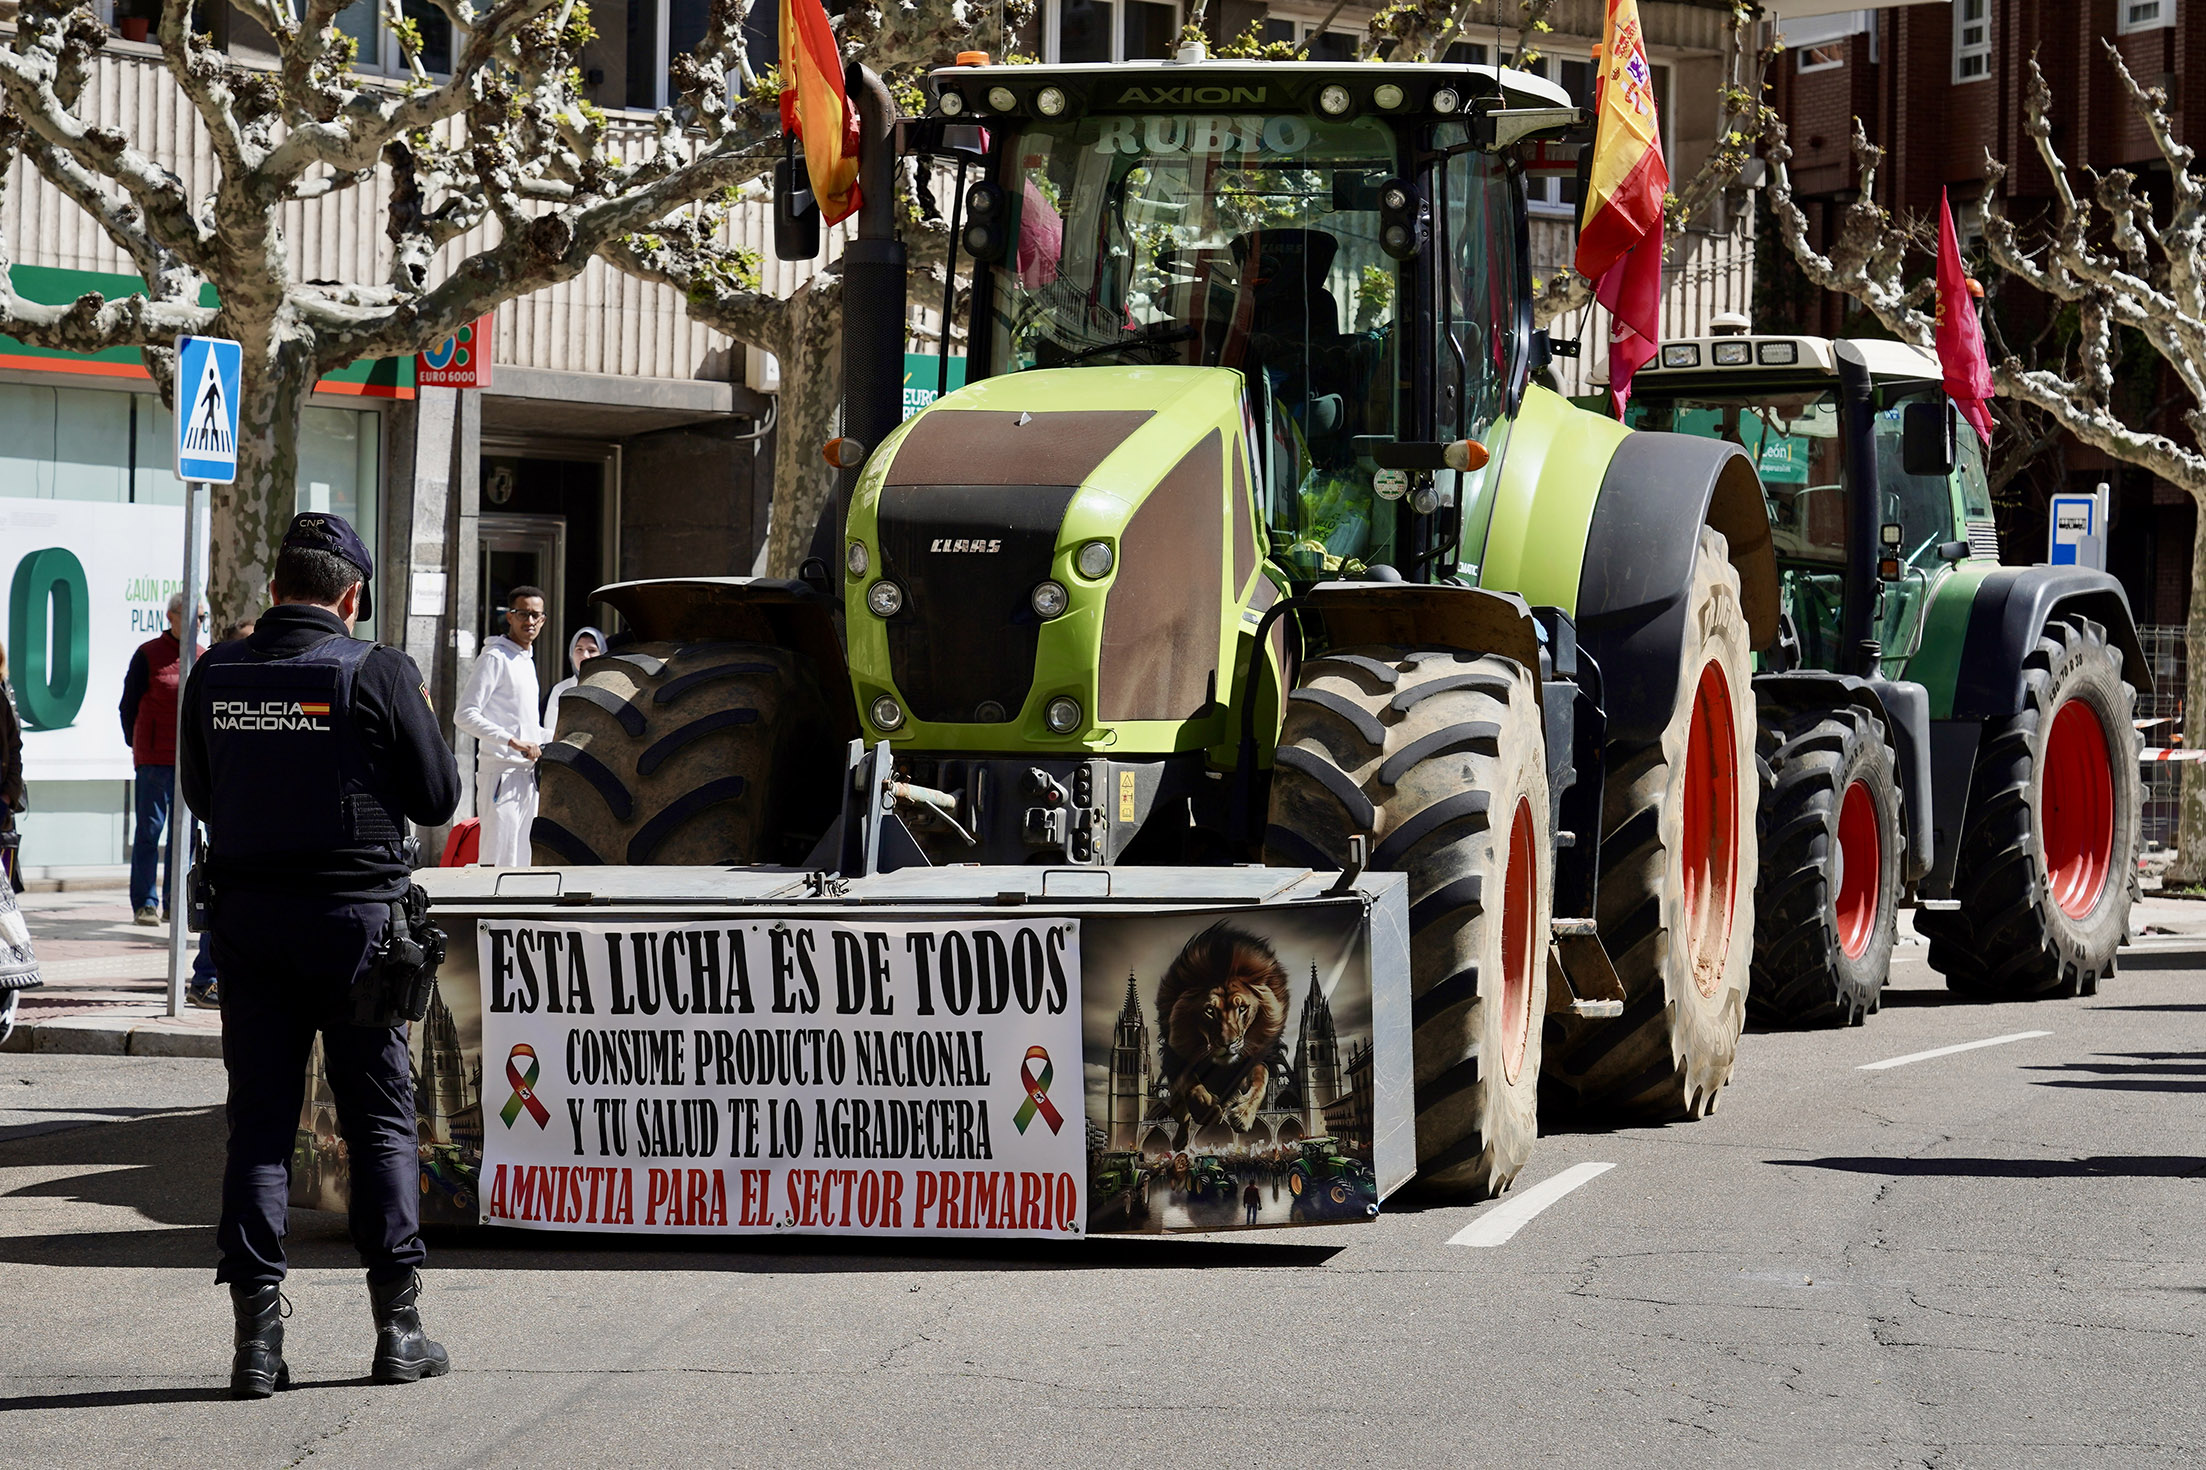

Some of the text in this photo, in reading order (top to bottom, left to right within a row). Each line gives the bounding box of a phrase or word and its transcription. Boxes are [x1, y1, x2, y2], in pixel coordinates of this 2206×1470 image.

[1116, 86, 1267, 104] AXION
[1095, 115, 1311, 154] RUBIO
[419, 371, 476, 382] EURO 6000
[299, 518, 325, 528] CNP
[930, 539, 1002, 553] CLAAS
[131, 609, 164, 632] PLAN
[213, 716, 331, 731] NACIONAL
[489, 926, 1068, 1016] ESTA LUCHA ES DE TODOS
[566, 1028, 991, 1087] CONSUME PRODUCTO NACIONAL
[567, 1098, 993, 1159] Y TU SALUD TE LO AGRADECERA
[490, 1164, 1077, 1232] AMNISTIA PARA EL SECTOR PRIMARIO
